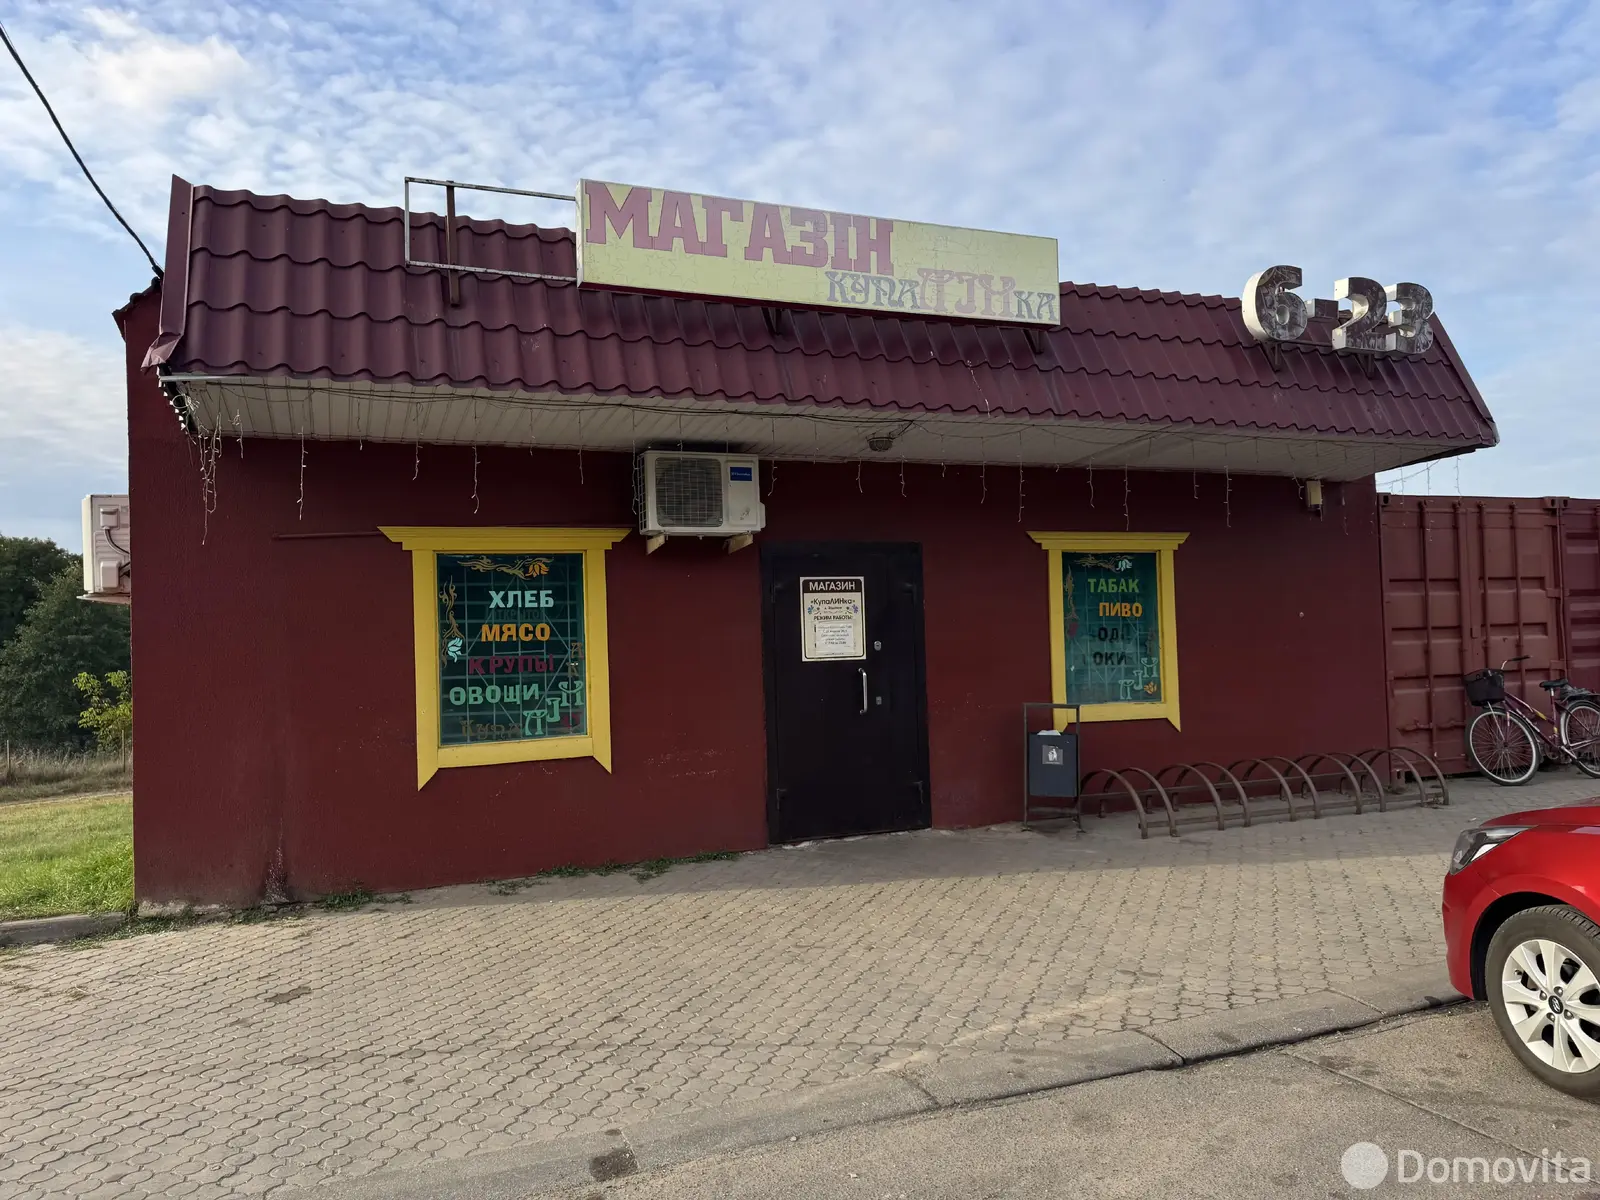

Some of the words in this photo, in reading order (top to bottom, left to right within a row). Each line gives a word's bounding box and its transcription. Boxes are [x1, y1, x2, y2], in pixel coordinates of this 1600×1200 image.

[585, 181, 894, 276] МАГАЗІН
[1242, 265, 1434, 354] 6-23
[809, 581, 856, 591] МАГАЗИН
[1087, 578, 1140, 593] ТАБАК
[488, 590, 554, 608] ХЛЕБ
[1099, 602, 1143, 617] ПИВО
[481, 623, 551, 642] МЯСО
[468, 655, 554, 675] КРУПЫ
[449, 683, 540, 706] ОВОЩИ
